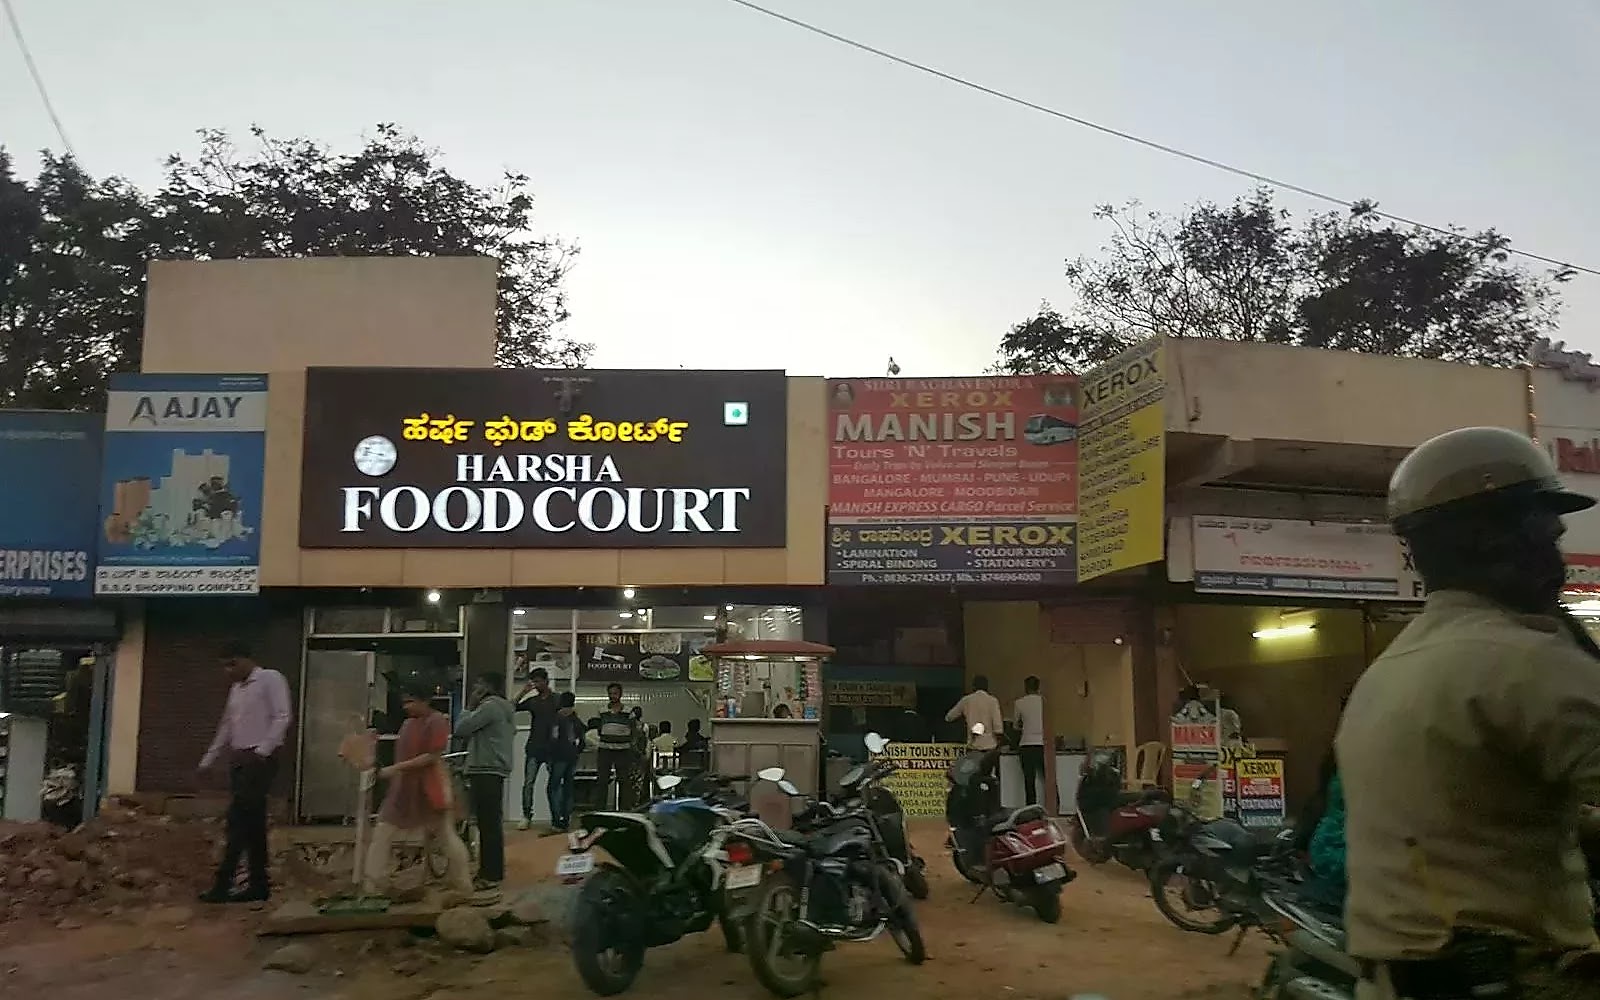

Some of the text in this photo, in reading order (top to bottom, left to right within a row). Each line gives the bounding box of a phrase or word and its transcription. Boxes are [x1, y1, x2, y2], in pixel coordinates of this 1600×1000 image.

[1082, 358, 1160, 409] XEROX
[890, 391, 1013, 408] XEROX
[835, 411, 1015, 442] MANISH
[832, 446, 895, 459] Tours
[942, 444, 1018, 458] Travels
[456, 453, 622, 482] HARSHA
[832, 473, 911, 485] BANGALORE
[919, 473, 975, 484] MUMBAI
[983, 472, 1019, 483] PUNE
[863, 487, 945, 498] MANGALORE
[340, 486, 751, 533] FOOD COURT
[830, 501, 883, 514] MANISH
[883, 501, 938, 513] EXPRESS
[940, 500, 984, 513] CARGO
[985, 500, 1026, 512] Parcel
[939, 526, 1074, 546] XEROX
[842, 548, 918, 558] LAMINATION
[974, 548, 1027, 557] COLOUR
[842, 559, 937, 569] SPIRAL BINDING
[135, 584, 193, 592] SHOPPING
[198, 584, 253, 592] COMPLEX
[584, 634, 635, 645] HARSHA
[871, 746, 908, 757] ANISH
[910, 746, 941, 757] TOURS
[1243, 761, 1278, 775] XEROX
